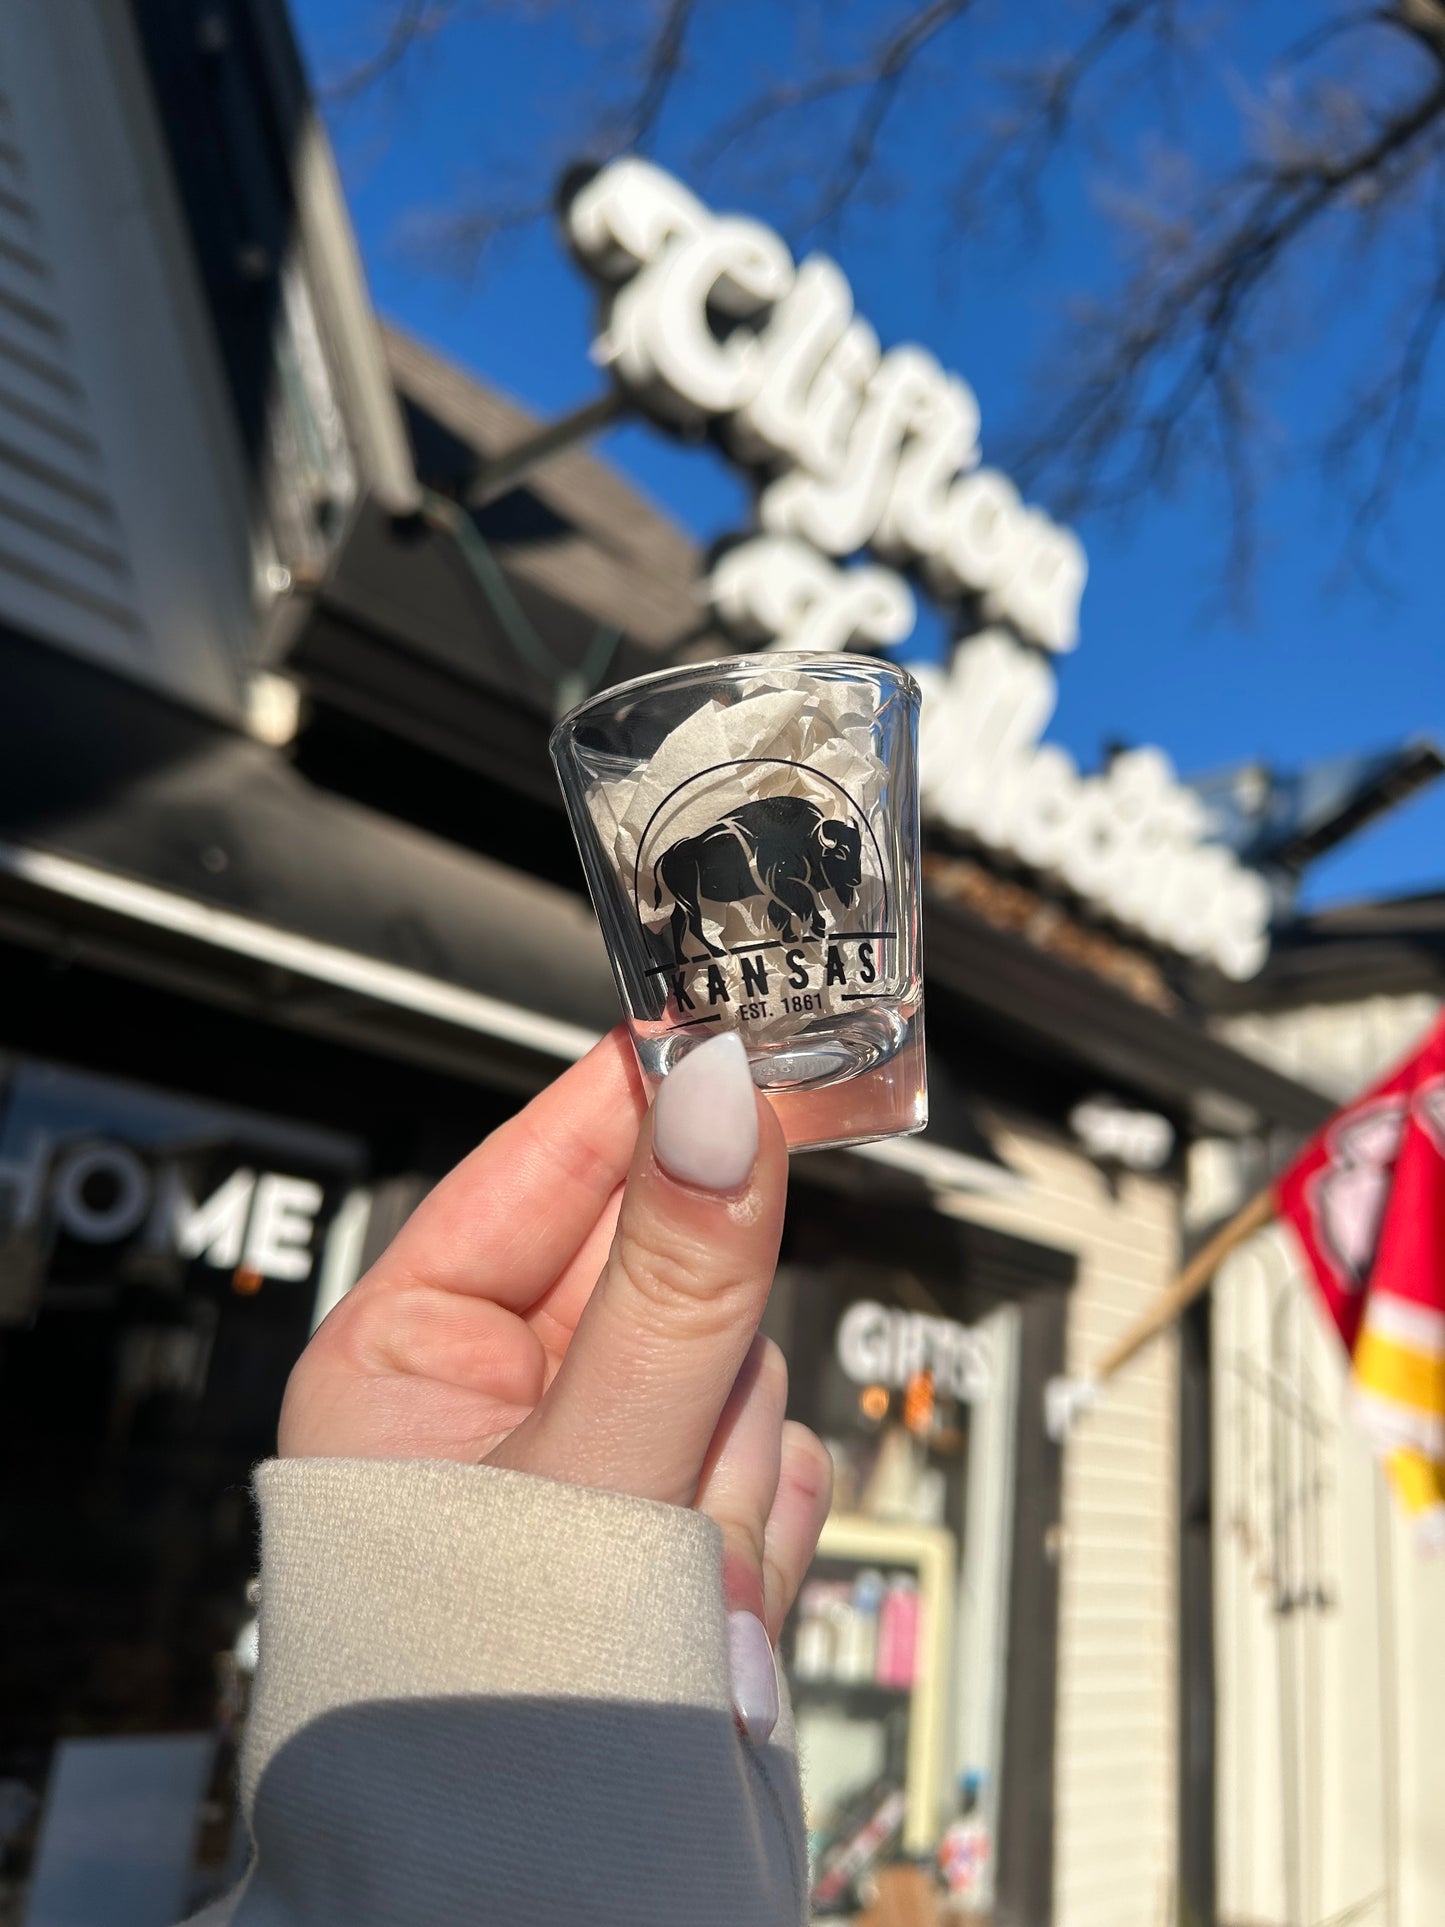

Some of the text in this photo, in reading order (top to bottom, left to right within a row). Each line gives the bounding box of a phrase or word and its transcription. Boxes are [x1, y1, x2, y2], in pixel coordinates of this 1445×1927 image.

[671, 942, 877, 1012] KANSAS
[739, 992, 823, 1021] EST. 1861
[837, 1300, 997, 1403] GIFTS
